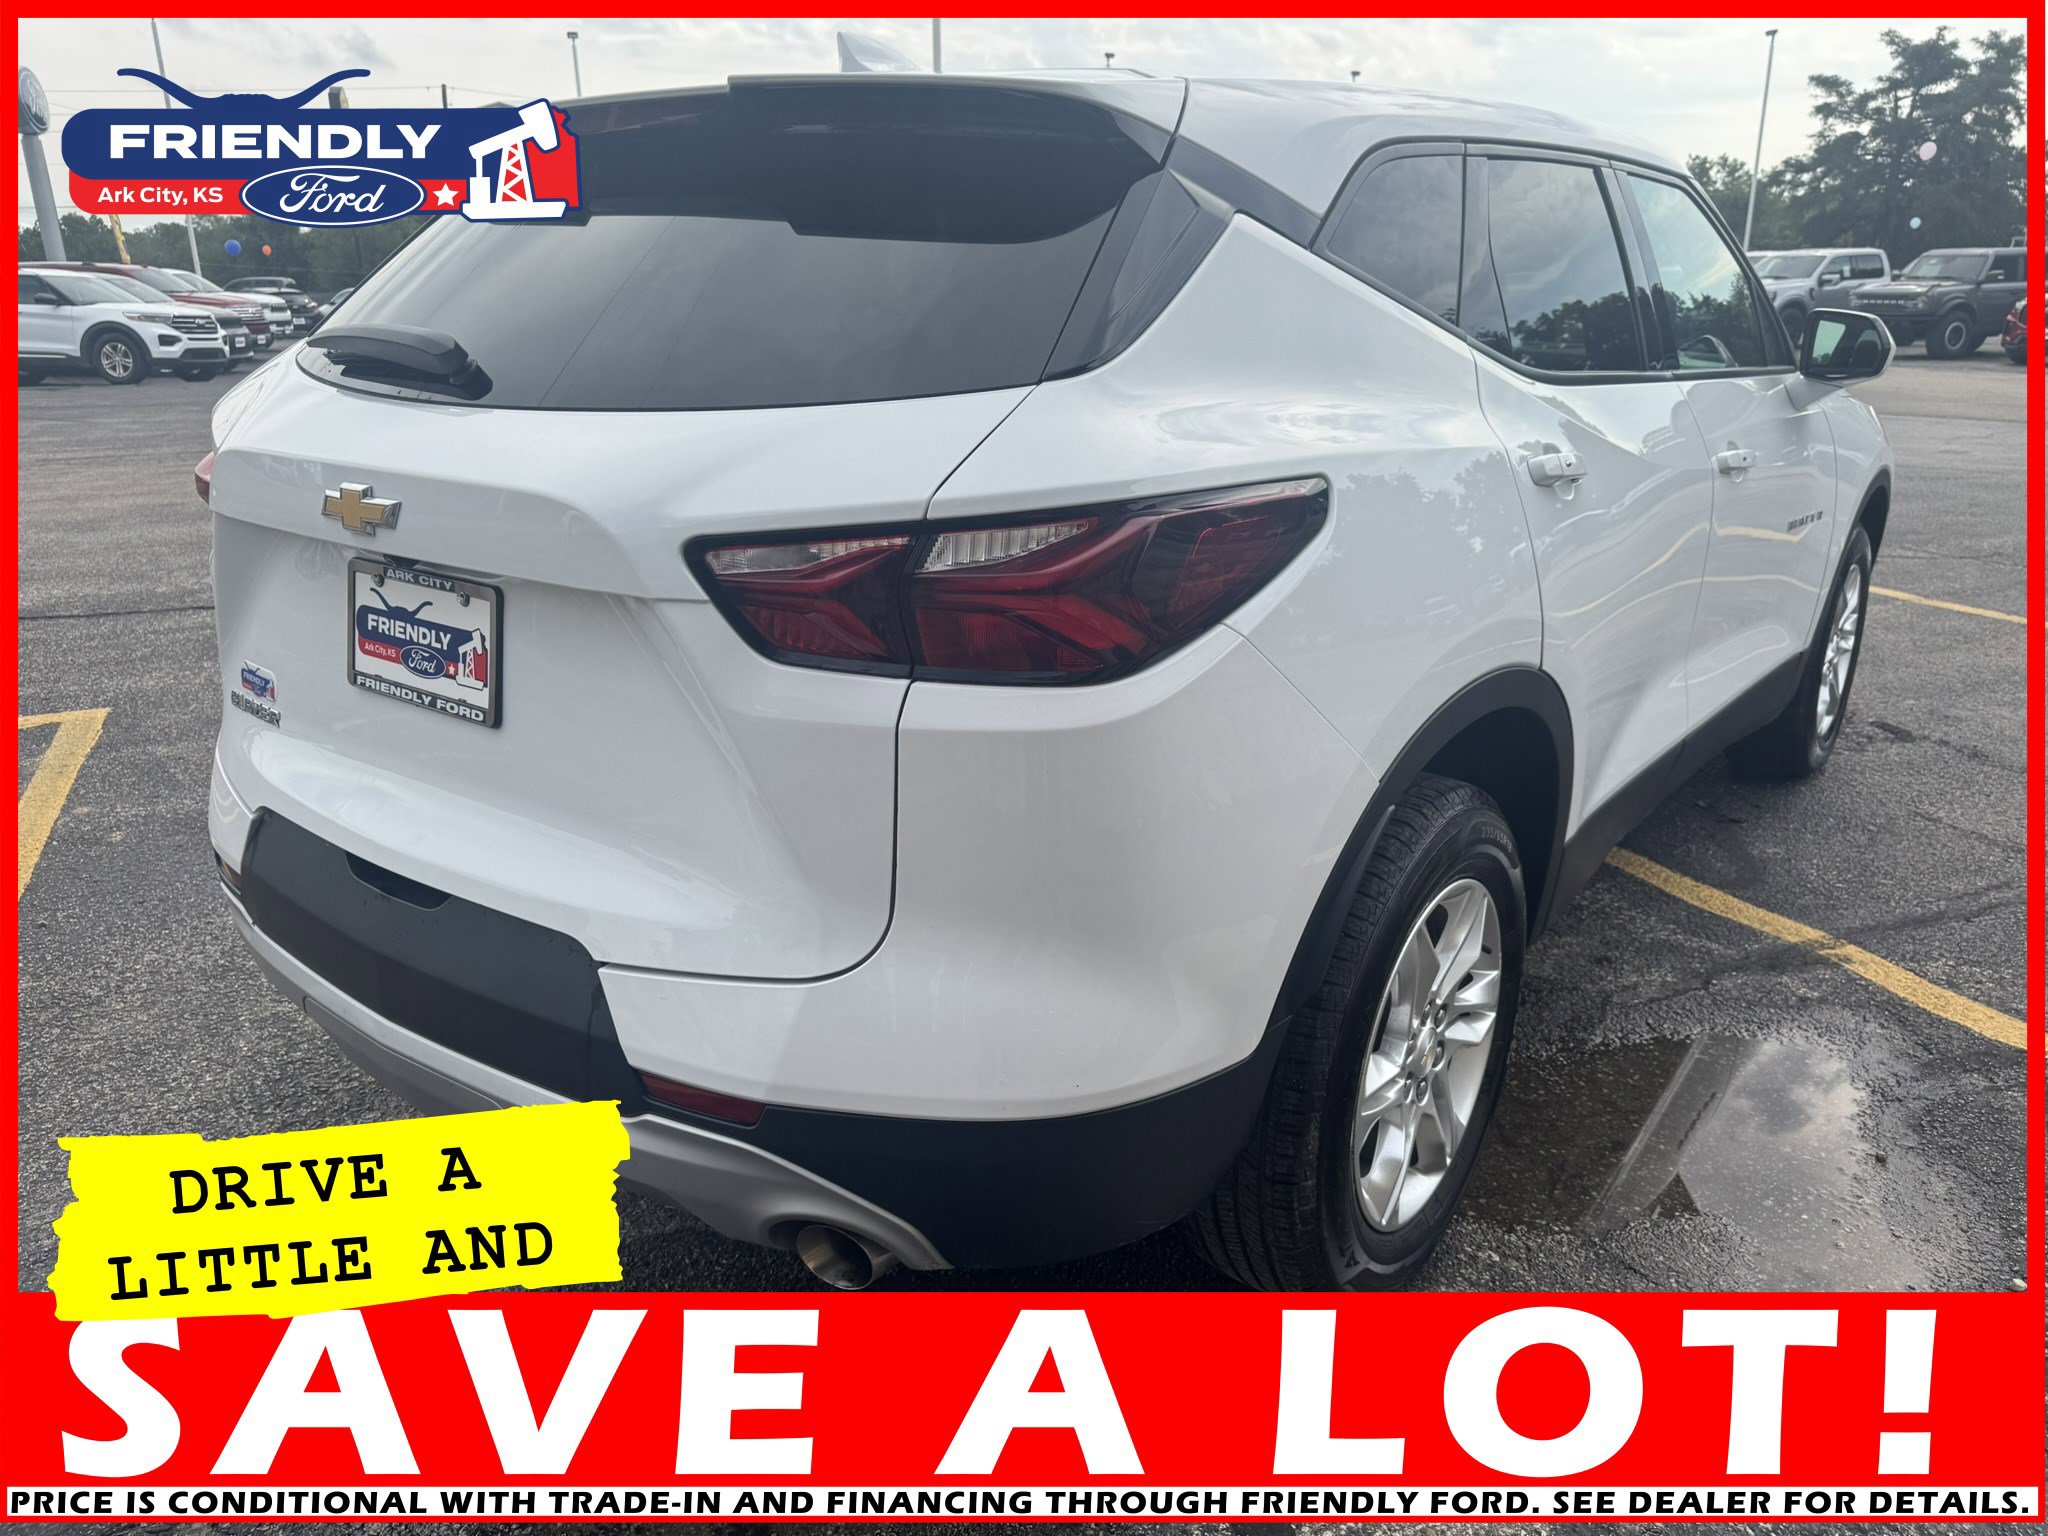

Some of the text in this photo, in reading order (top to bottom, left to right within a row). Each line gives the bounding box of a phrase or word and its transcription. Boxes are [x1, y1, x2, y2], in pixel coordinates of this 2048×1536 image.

[386, 569, 453, 590] ARK CITY
[367, 613, 451, 650] FRIENDLY
[365, 642, 375, 651] Ark
[388, 650, 396, 658] KS
[408, 648, 437, 674] Ford
[356, 675, 484, 722] FRIENDLY FORD
